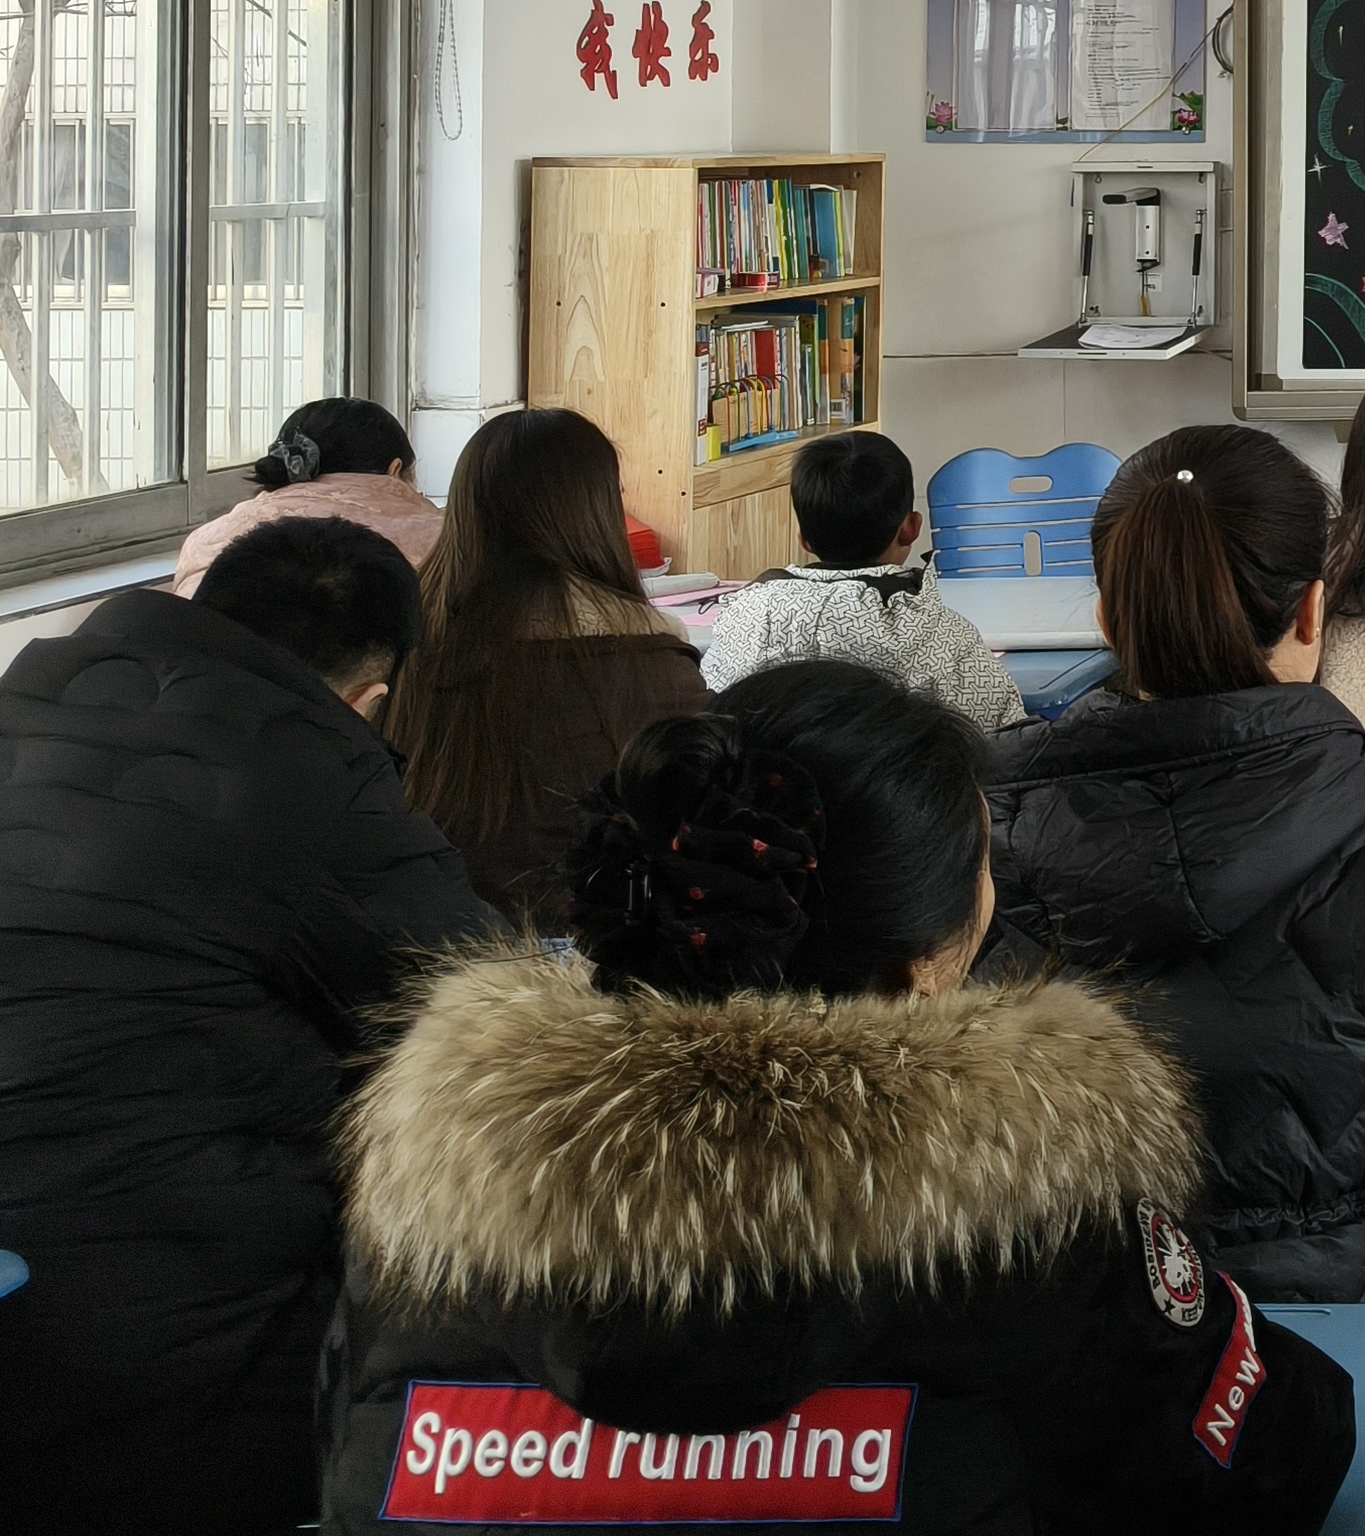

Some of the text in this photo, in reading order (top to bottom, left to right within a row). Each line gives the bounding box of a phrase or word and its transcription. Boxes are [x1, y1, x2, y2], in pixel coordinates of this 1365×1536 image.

[1206, 1347, 1261, 1447] New
[406, 1412, 892, 1494] Speed running
